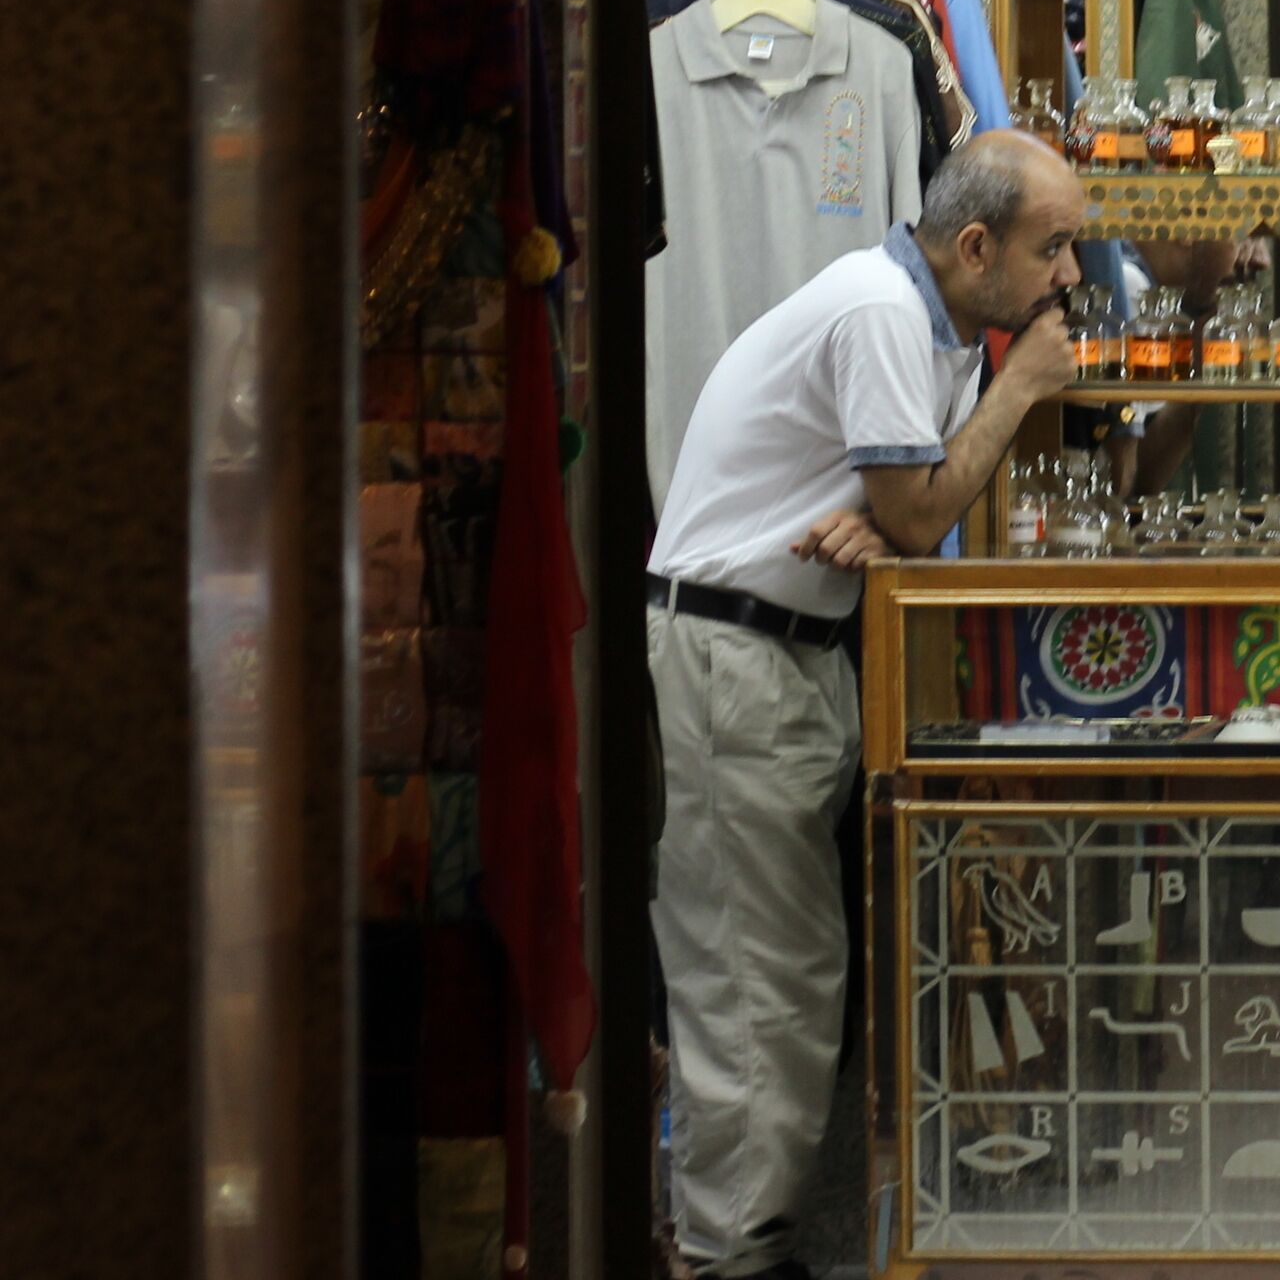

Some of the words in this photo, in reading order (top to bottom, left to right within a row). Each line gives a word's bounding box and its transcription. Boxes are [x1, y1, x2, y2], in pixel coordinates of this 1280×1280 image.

[1029, 865, 1054, 904] A
[1160, 871, 1187, 905] B
[1043, 982, 1058, 1018] I
[1170, 981, 1193, 1015] J
[1029, 1107, 1057, 1138] R
[1169, 1106, 1190, 1135] S
